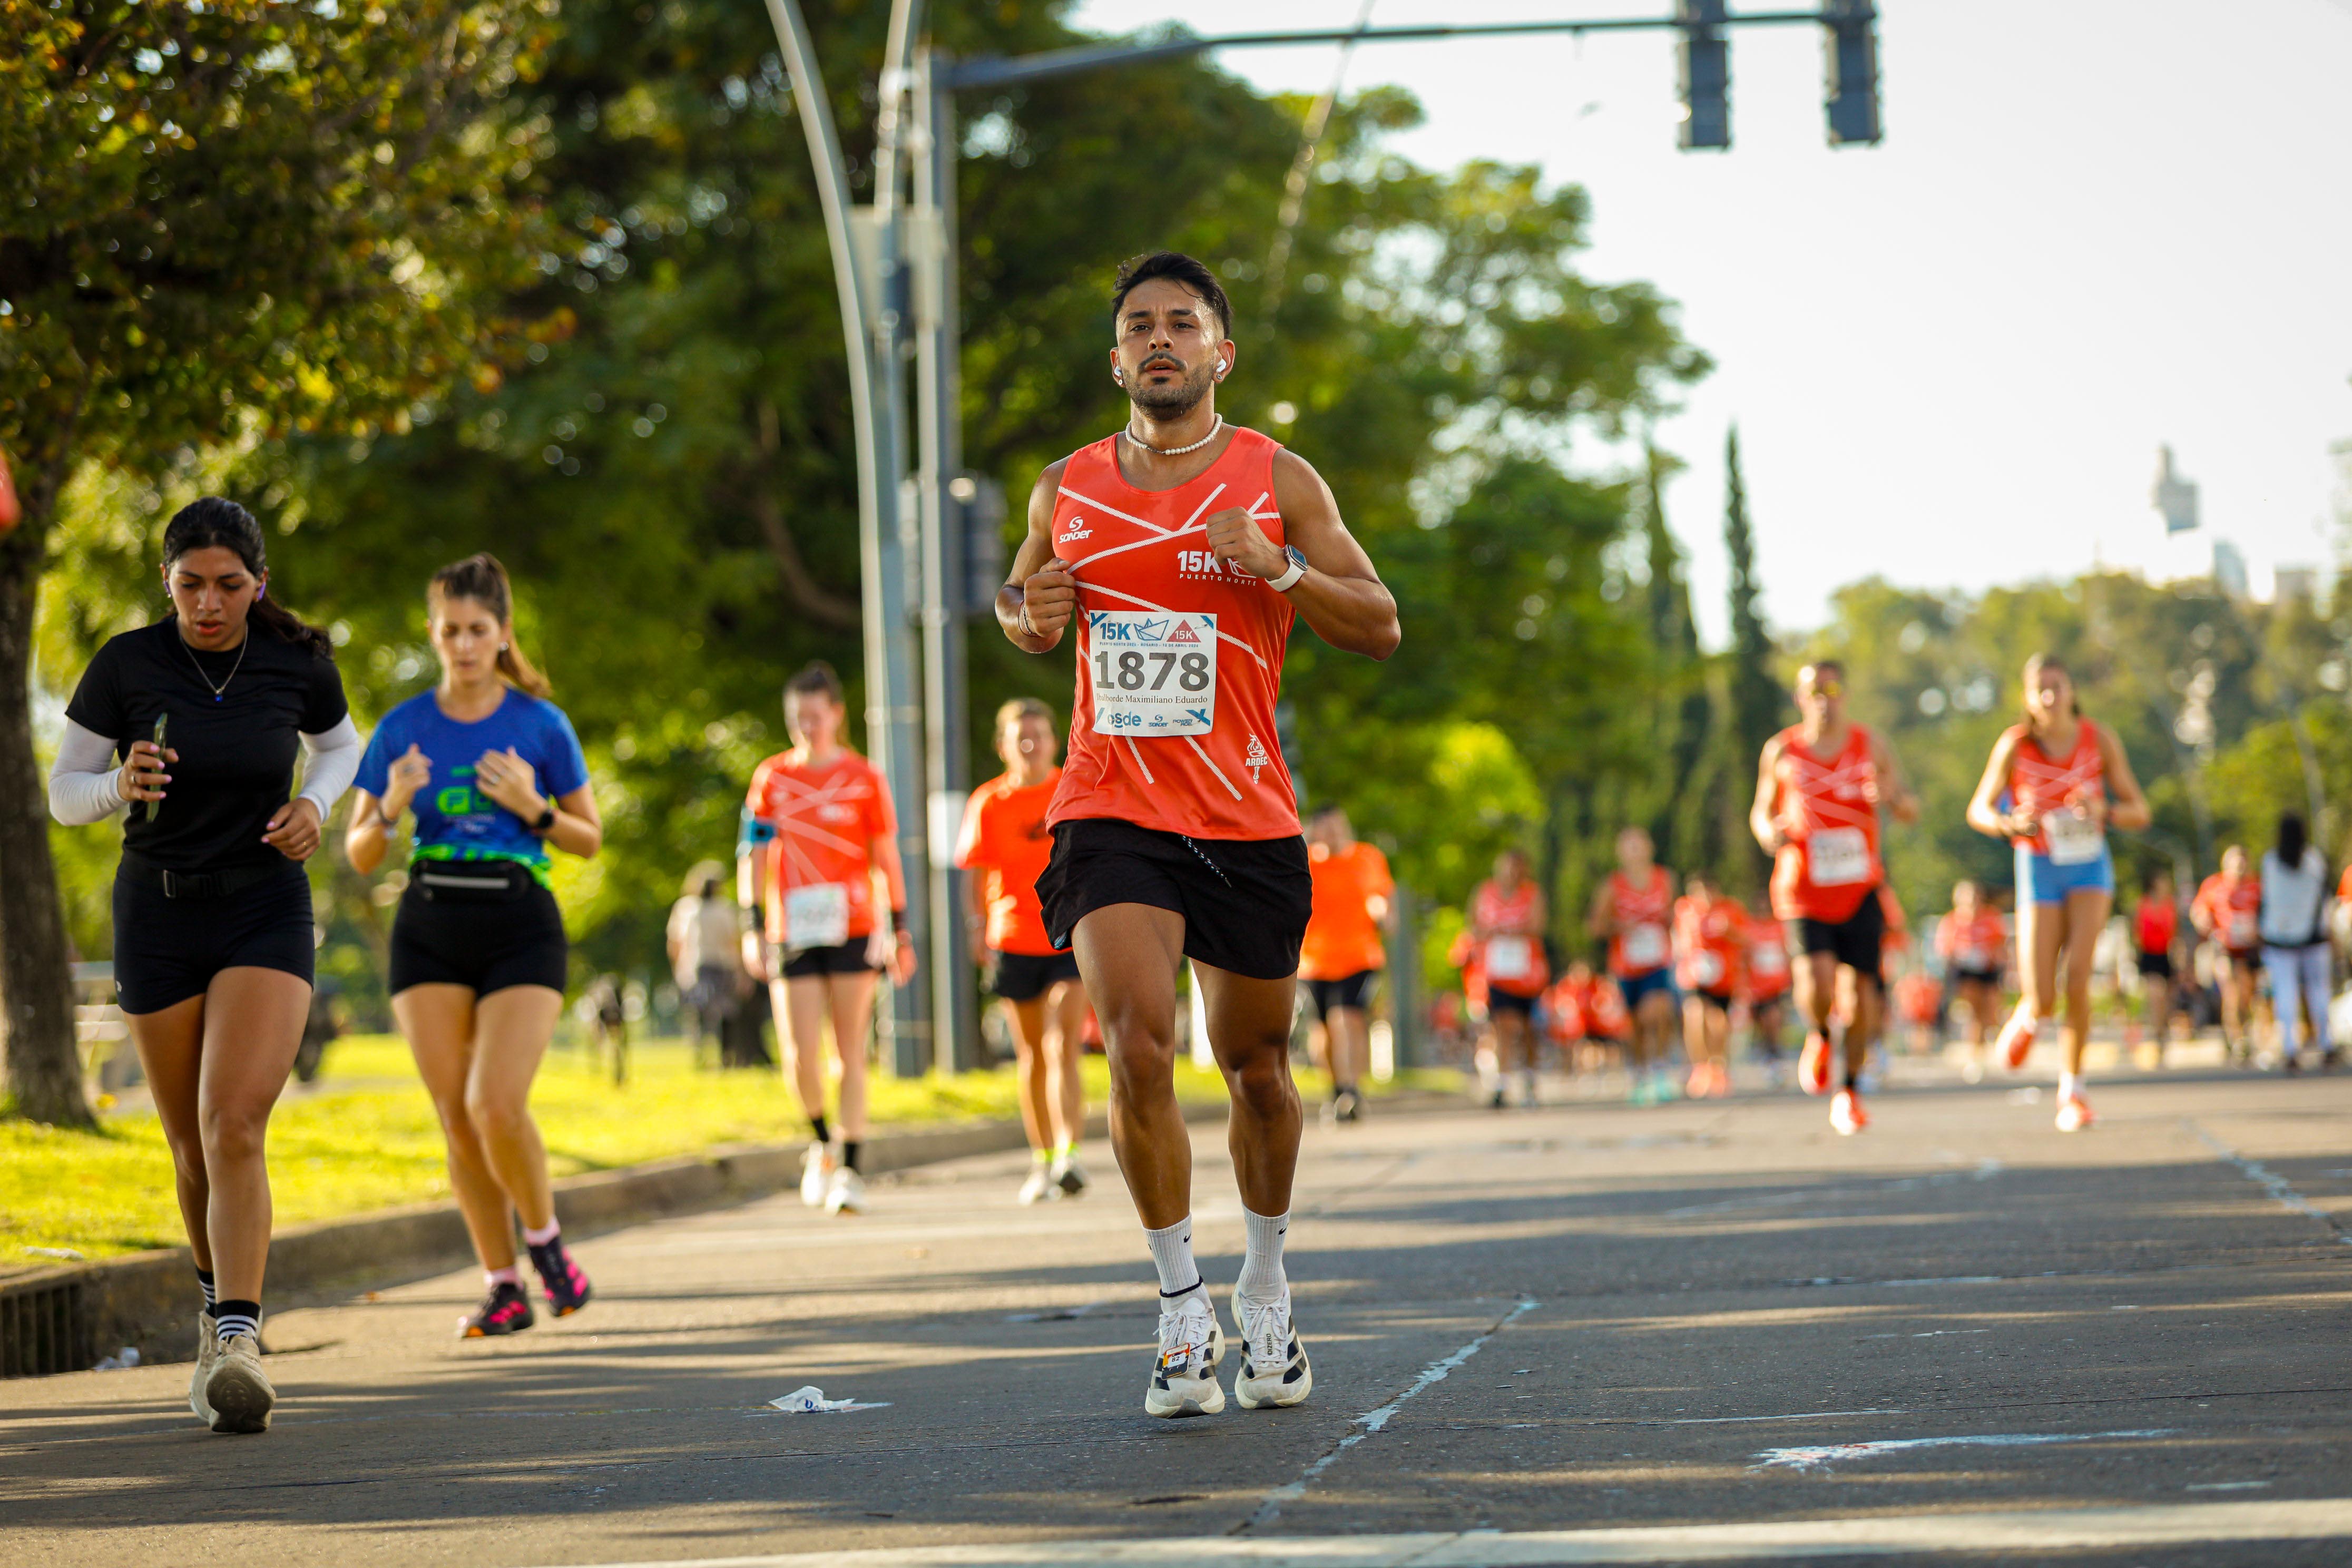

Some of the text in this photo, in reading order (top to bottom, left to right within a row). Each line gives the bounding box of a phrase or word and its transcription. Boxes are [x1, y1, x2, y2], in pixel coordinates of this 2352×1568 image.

[1177, 551, 1222, 573] 15K
[1227, 577, 1256, 586] NORTE
[1100, 622, 1131, 641] 15K
[1174, 630, 1194, 639] 15K
[1095, 651, 1209, 691] 1878
[1125, 695, 1173, 703] Maximiliano
[1108, 711, 1142, 727] osde
[1245, 756, 1268, 766] ARDEC
